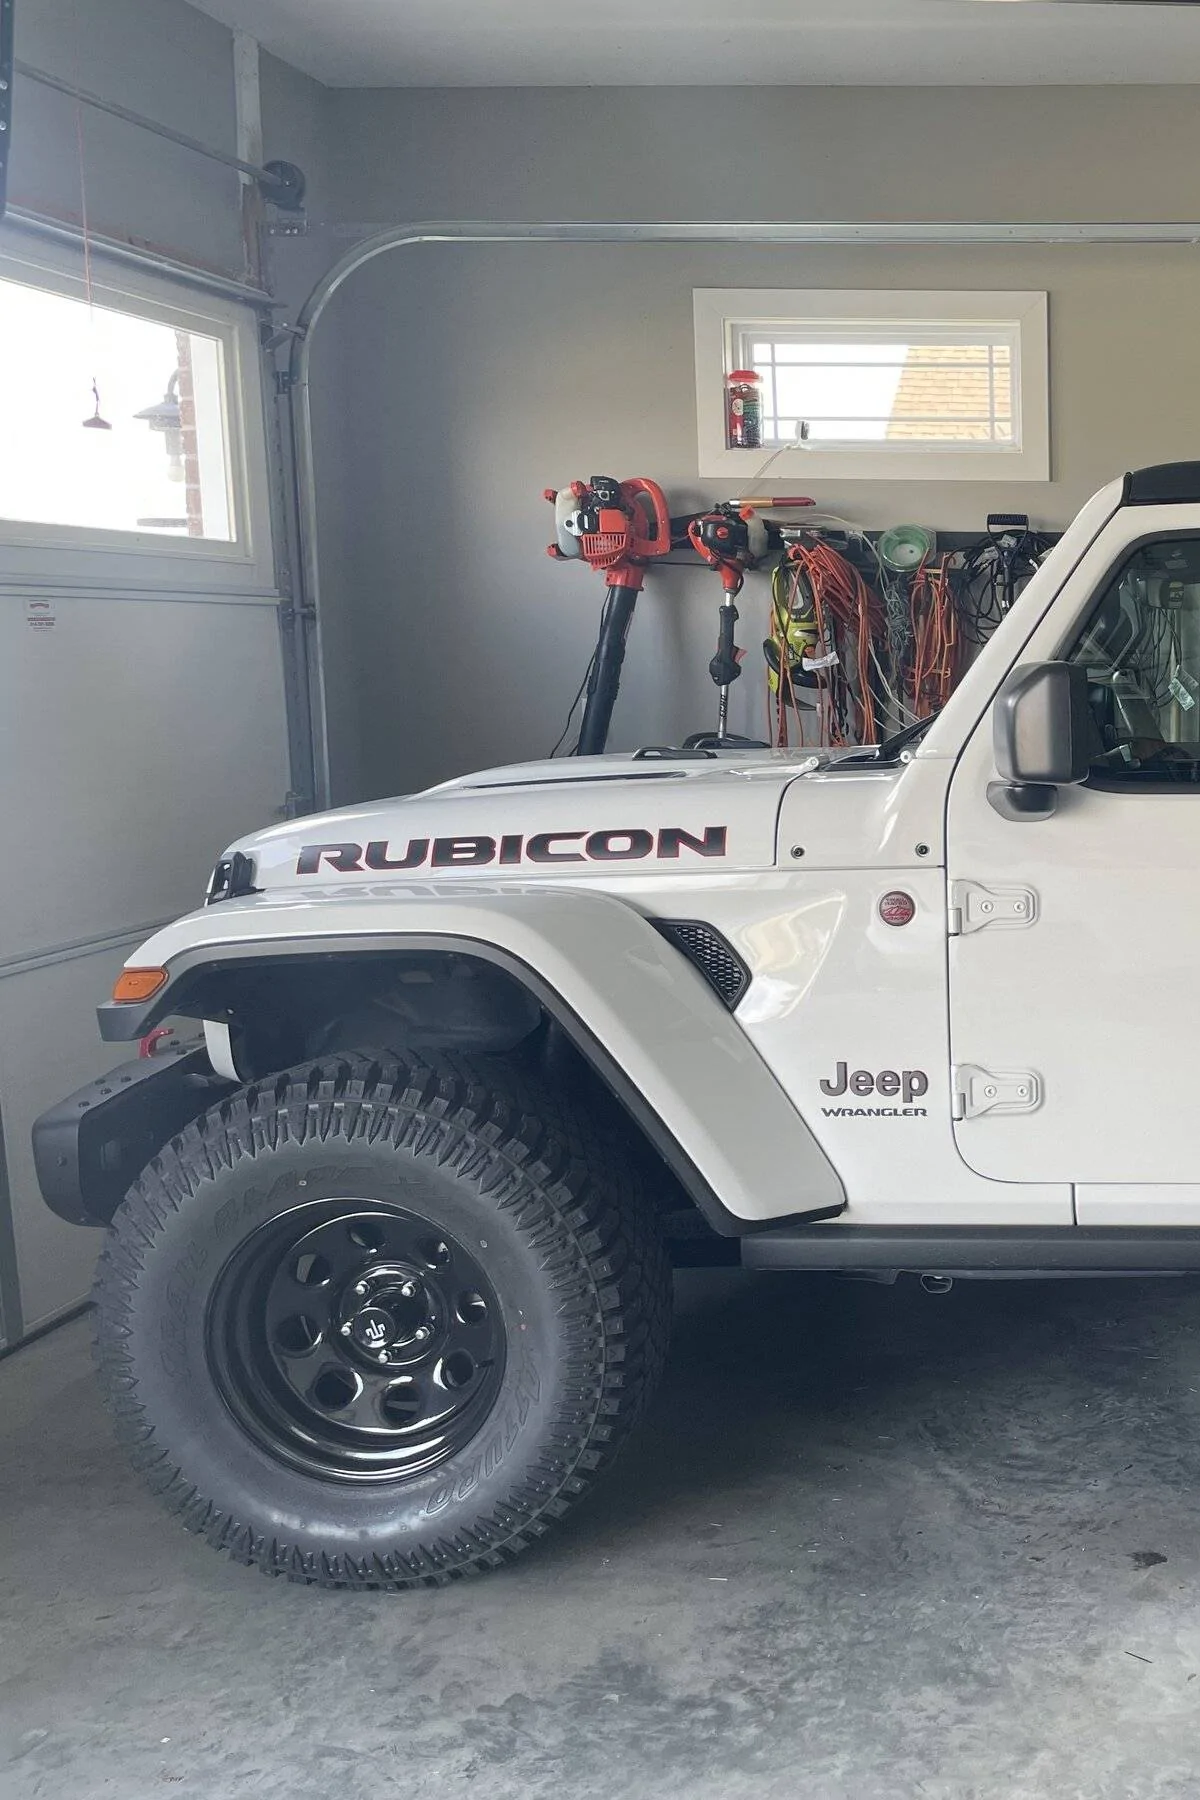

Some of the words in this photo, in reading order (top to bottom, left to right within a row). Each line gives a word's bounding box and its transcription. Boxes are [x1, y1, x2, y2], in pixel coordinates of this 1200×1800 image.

[296, 825, 727, 875] RUBICON
[819, 1061, 929, 1104] Jeep
[820, 1107, 928, 1117] WRANGLER
